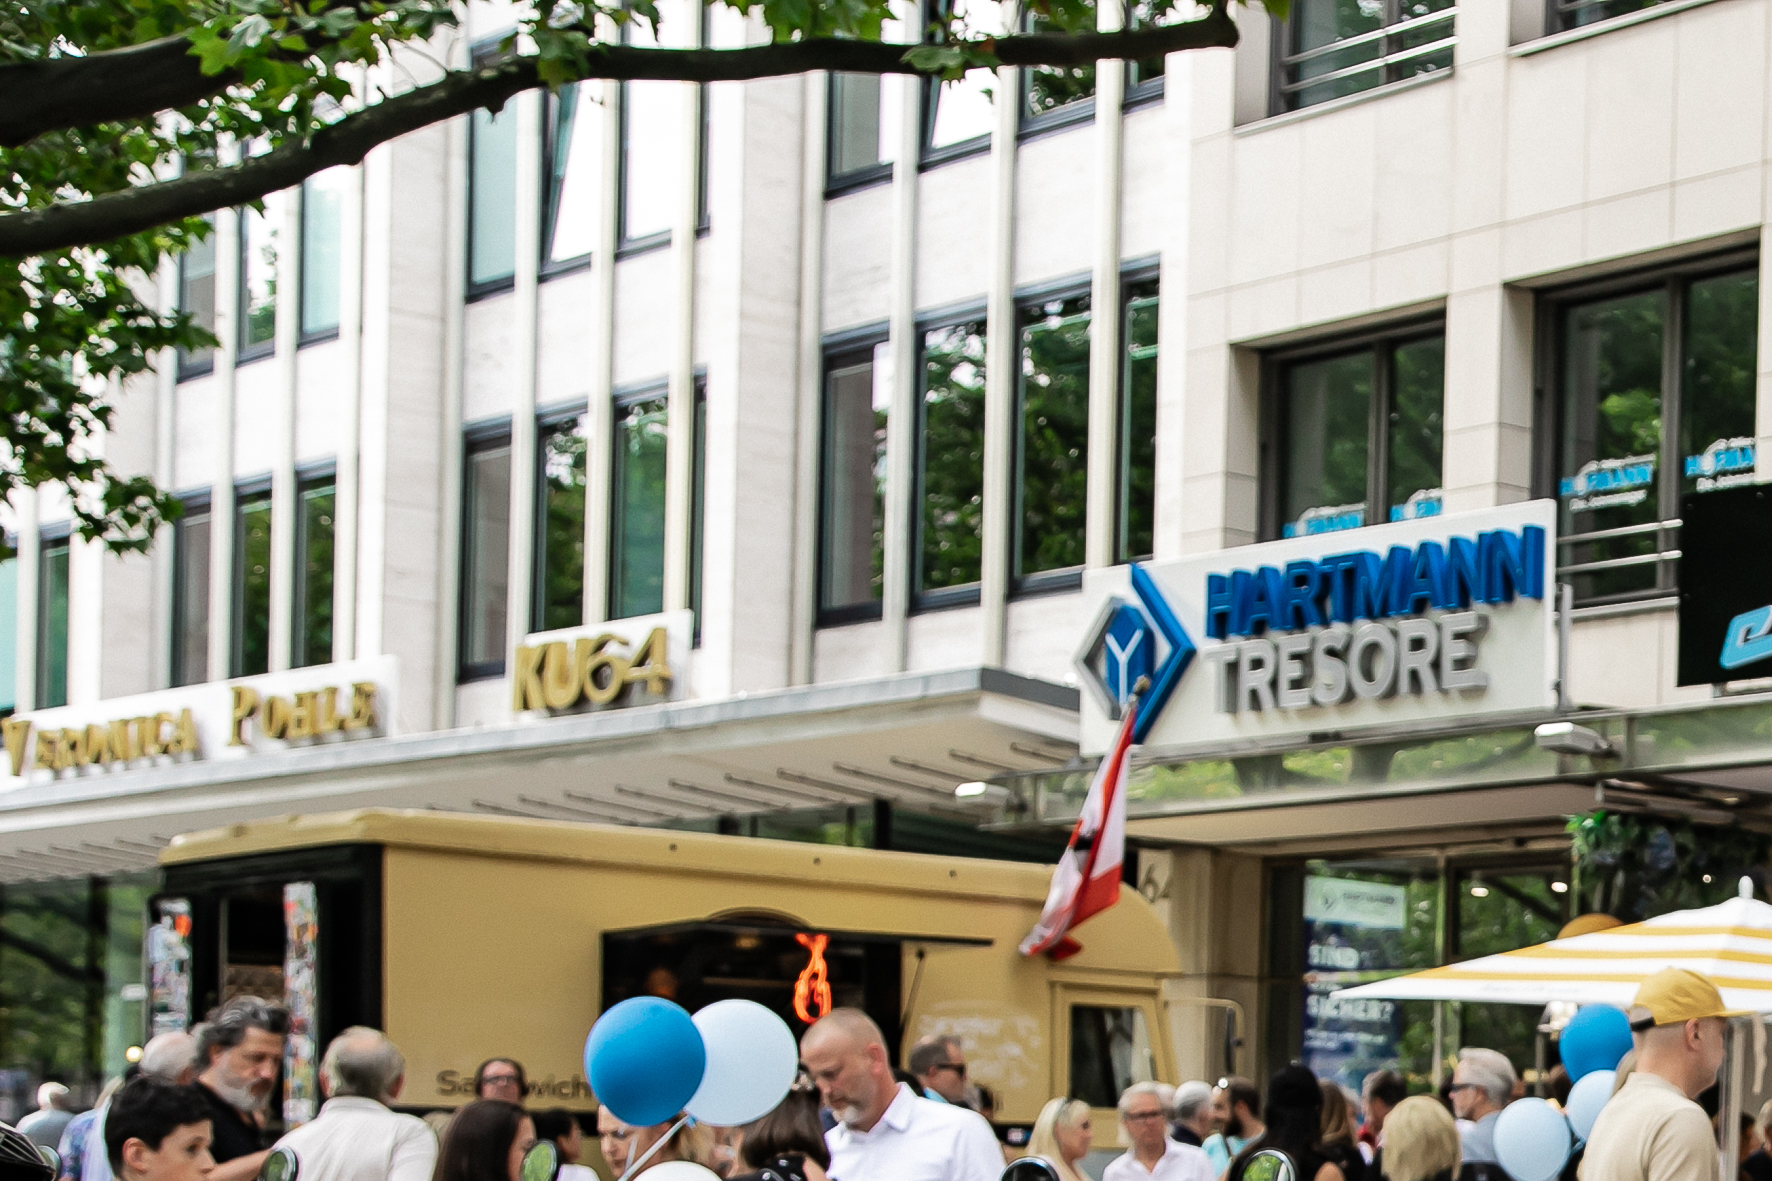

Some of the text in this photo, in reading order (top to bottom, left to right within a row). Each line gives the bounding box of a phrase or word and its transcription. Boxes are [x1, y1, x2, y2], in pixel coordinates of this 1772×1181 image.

[1205, 524, 1546, 640] HARTMANN
[513, 627, 673, 712] KU64
[1203, 610, 1489, 715] TRESORE
[436, 1069, 593, 1099] Sawich
